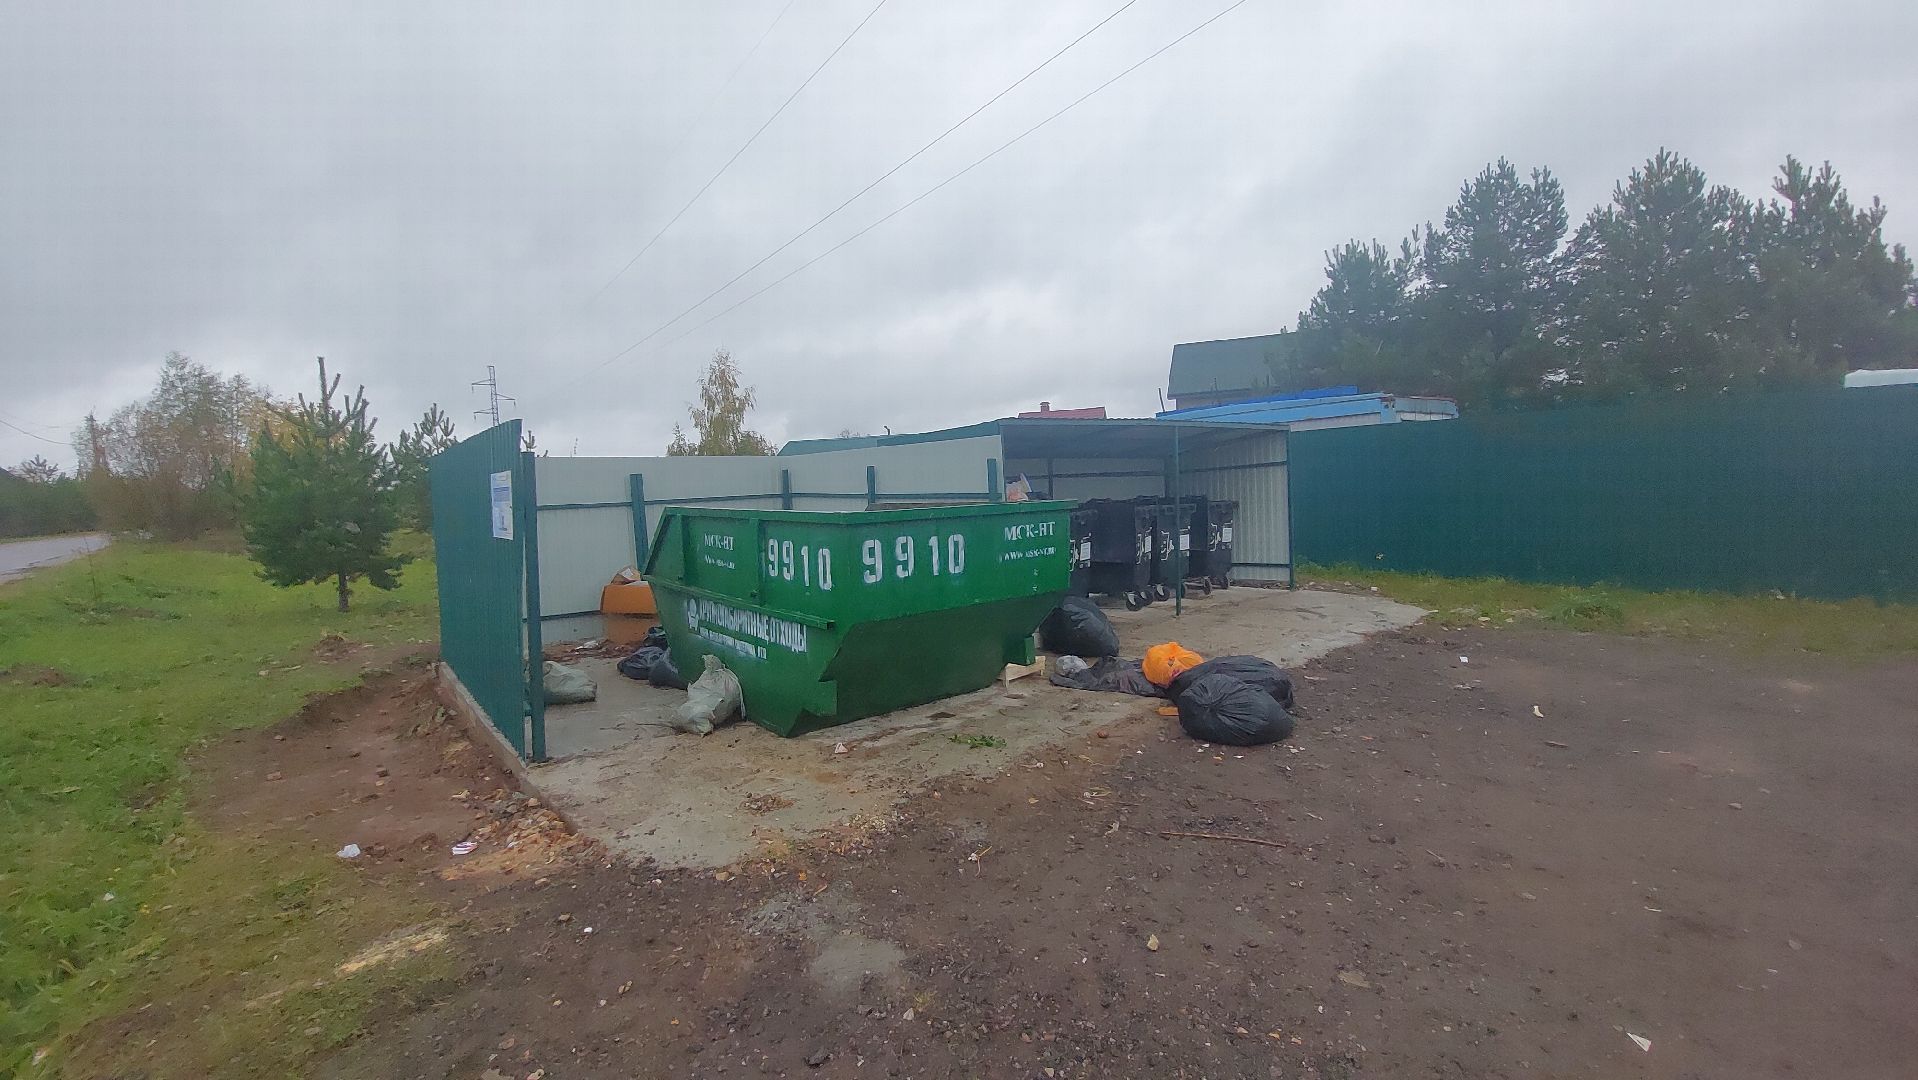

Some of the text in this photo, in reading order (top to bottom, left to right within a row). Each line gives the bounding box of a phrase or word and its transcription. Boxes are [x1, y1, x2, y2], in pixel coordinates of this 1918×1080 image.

[768, 538, 833, 591] 9910
[862, 533, 965, 584] 9910
[769, 617, 807, 654] ОТХОДЫ
